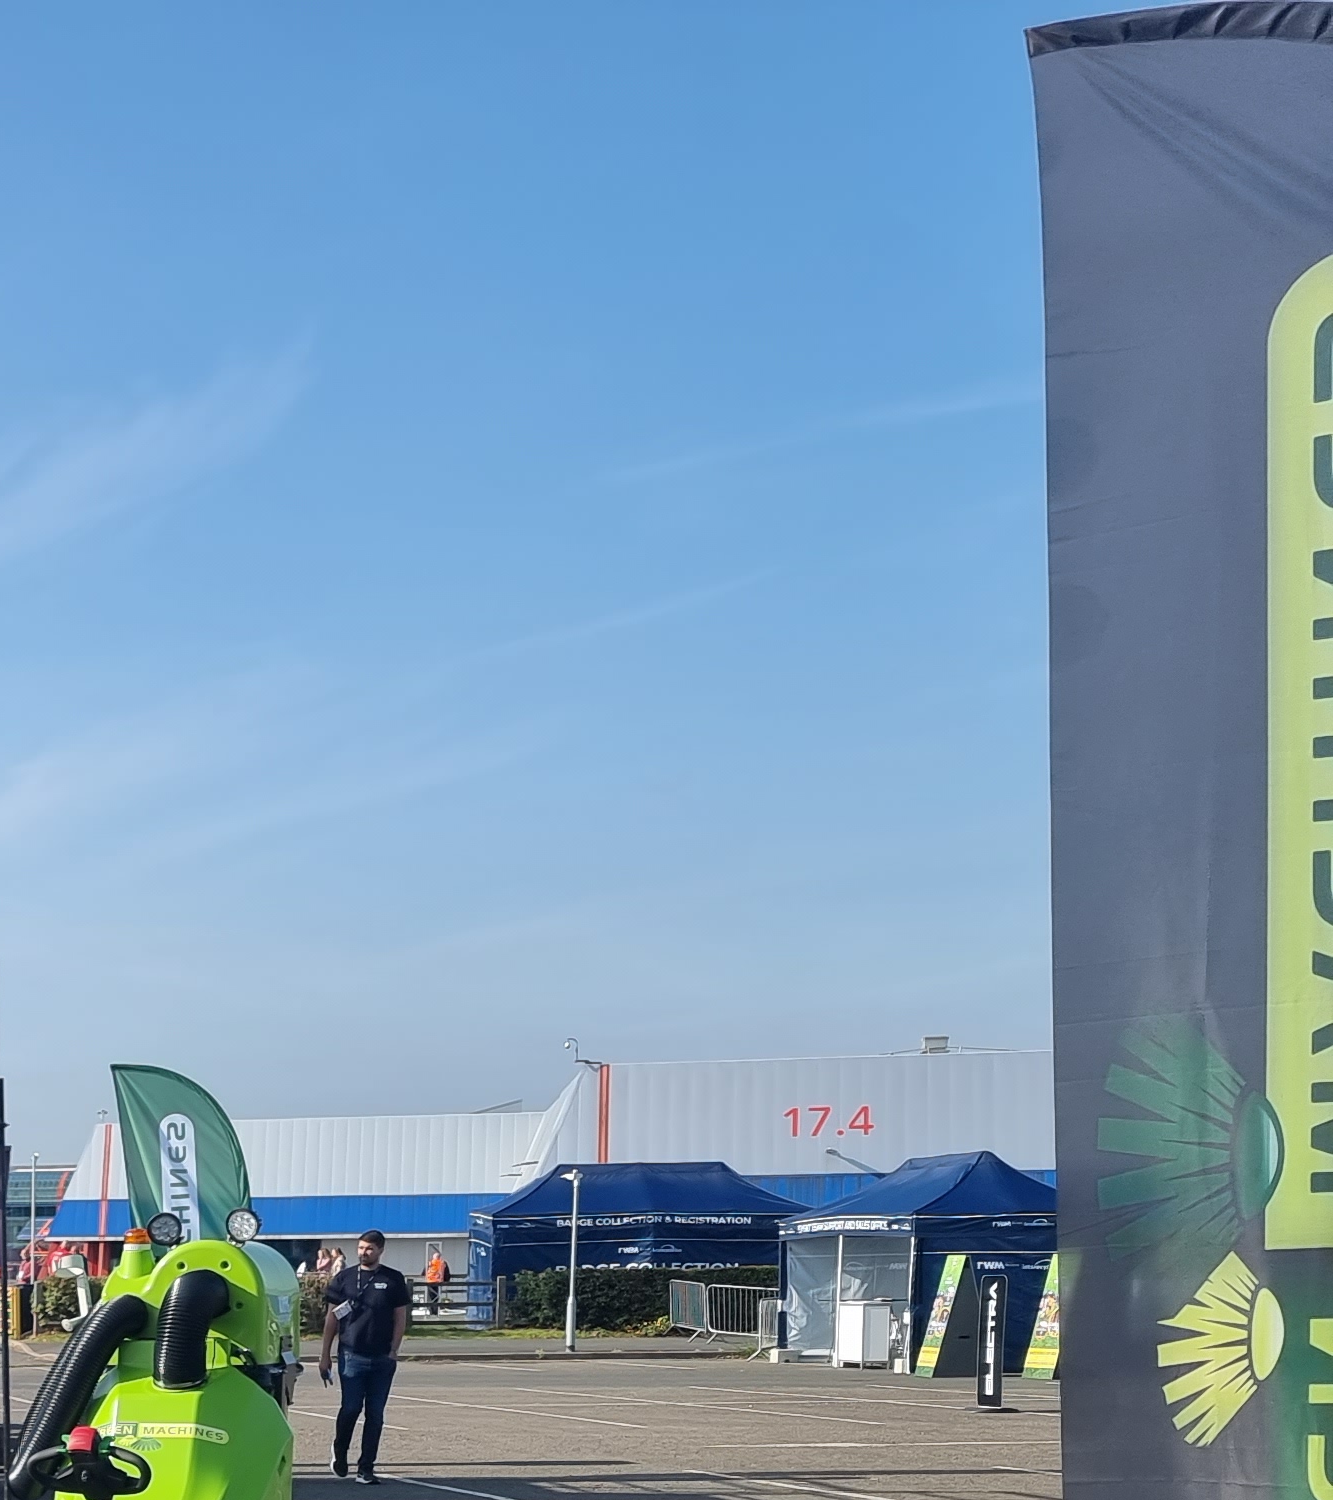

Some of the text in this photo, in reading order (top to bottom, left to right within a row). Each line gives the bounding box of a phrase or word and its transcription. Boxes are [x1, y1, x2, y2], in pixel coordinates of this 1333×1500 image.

[782, 1104, 876, 1138] 17.4
[556, 1218, 594, 1228] BAGE
[595, 1215, 663, 1227] COLLECTION
[674, 1216, 752, 1225] REGISTRATION
[985, 1281, 999, 1396] ELECTRA
[99, 1424, 224, 1441] REEN MACHINES
